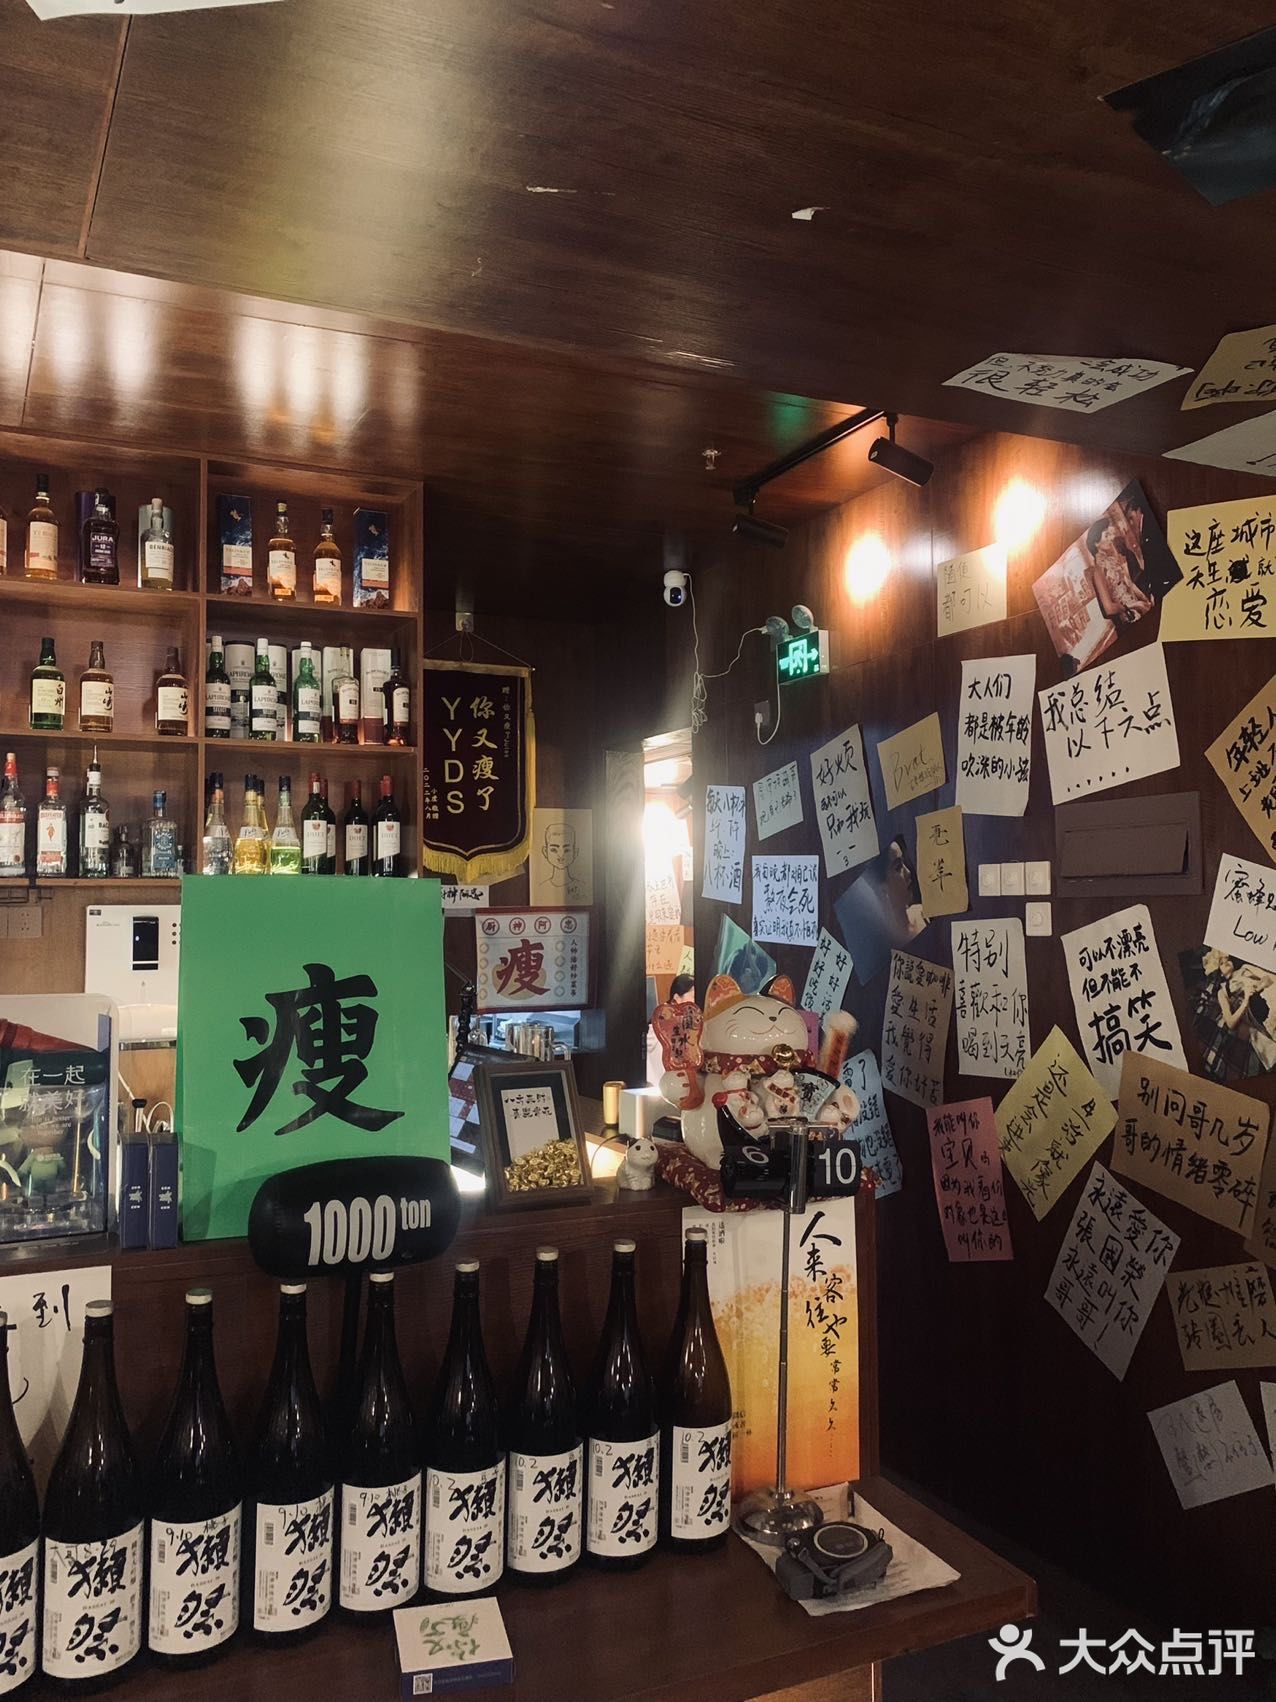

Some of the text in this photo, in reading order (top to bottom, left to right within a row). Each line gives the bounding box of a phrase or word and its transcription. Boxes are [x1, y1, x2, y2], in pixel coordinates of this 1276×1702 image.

[92, 534, 114, 542] JURA
[1184, 510, 1276, 556] 这座城市
[1205, 583, 1268, 630] 恋爱
[967, 673, 1012, 699] 大人们
[1043, 669, 1126, 733] 我总结
[441, 696, 466, 815] YYDS
[469, 695, 500, 812] 你又瘦了
[816, 740, 858, 786] 好烦
[763, 883, 815, 915] 熬夜会死
[496, 938, 551, 996] 瘦
[957, 928, 1009, 978] 特别
[1078, 922, 1150, 973] 可以不漂亮
[1082, 963, 1143, 1004] 但不能不
[233, 963, 406, 1137] 瘦
[1088, 989, 1173, 1066] 搞笑
[21, 1064, 86, 1086] 在一起
[1136, 1077, 1259, 1157] 别问哥几岁
[818, 1147, 857, 1185] 10
[1121, 1118, 1257, 1228] 哥的情绪零碎
[303, 1194, 432, 1266] 1000 ton
